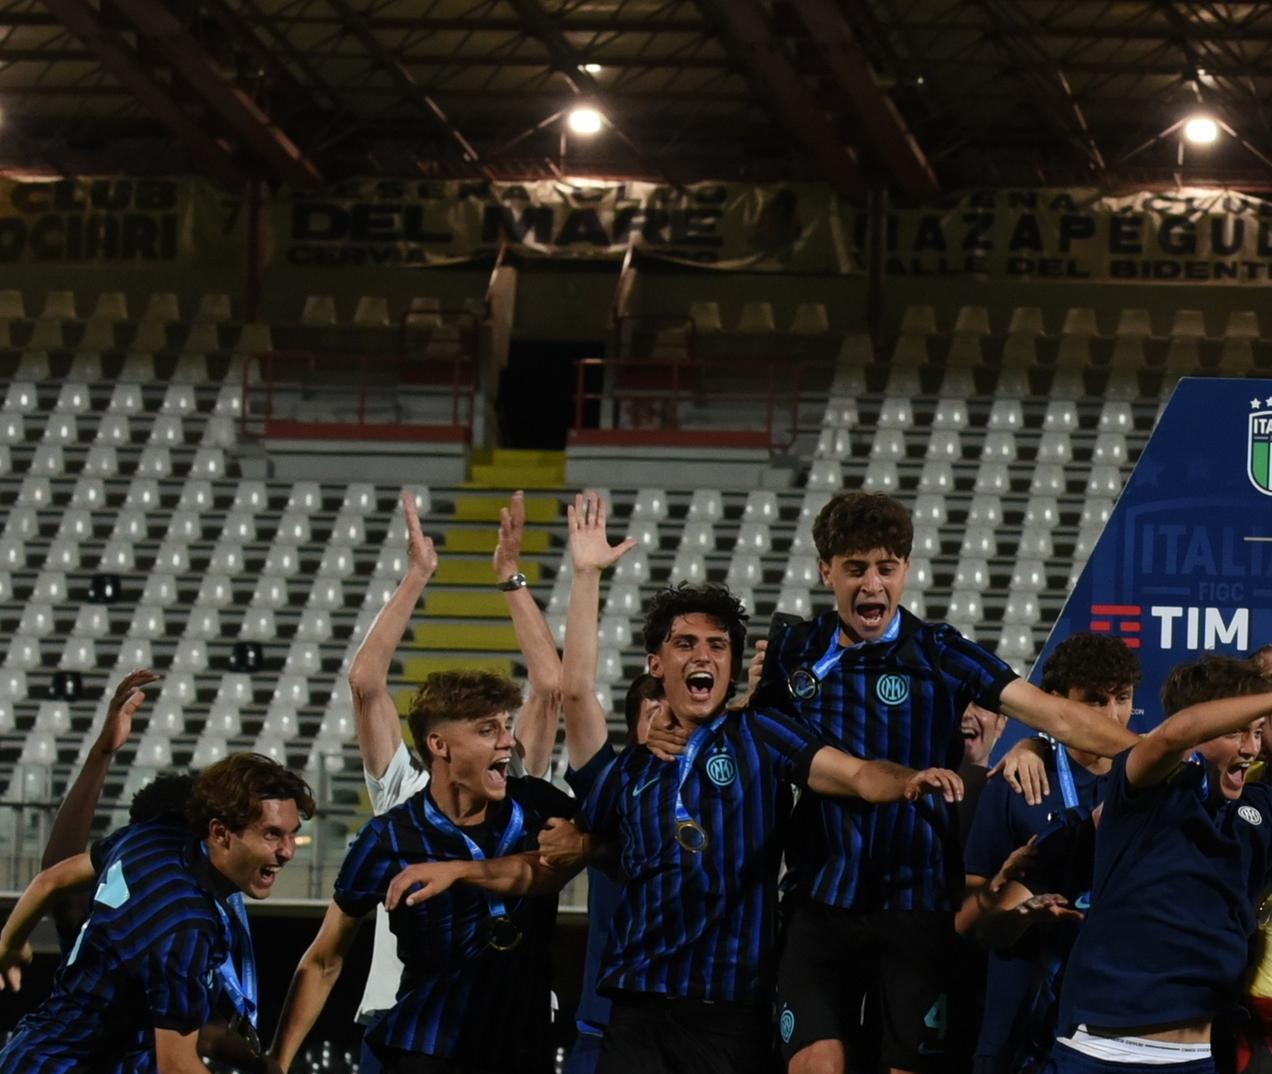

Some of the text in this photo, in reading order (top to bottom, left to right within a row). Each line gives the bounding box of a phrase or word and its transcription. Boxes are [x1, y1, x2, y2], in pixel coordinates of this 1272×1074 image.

[11, 180, 178, 211] CLUB
[292, 204, 723, 247] DEL MARE
[1006, 257, 1091, 277] DEL
[1199, 582, 1246, 601] FIGC
[1150, 605, 1250, 651] TIM
[923, 992, 948, 1040] 4
